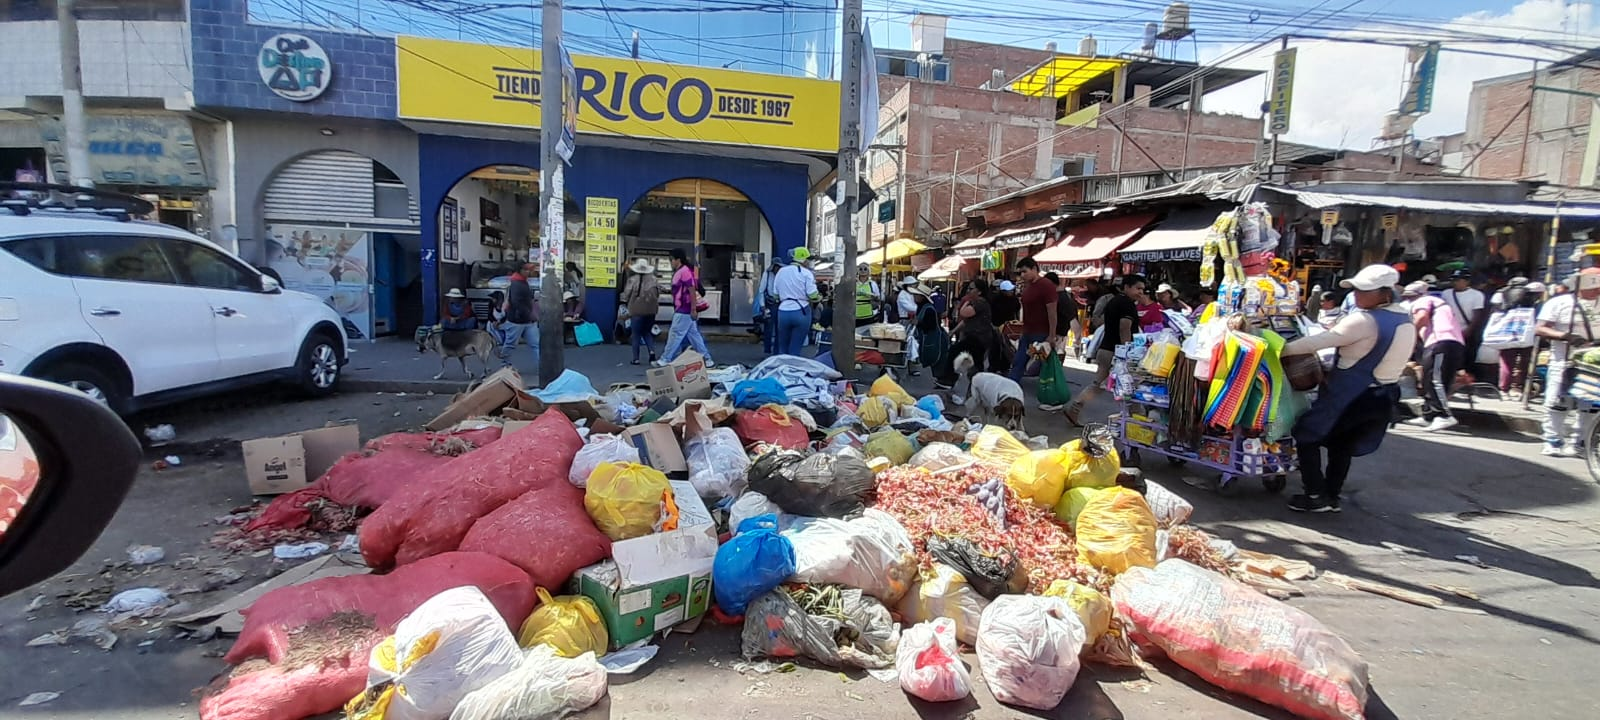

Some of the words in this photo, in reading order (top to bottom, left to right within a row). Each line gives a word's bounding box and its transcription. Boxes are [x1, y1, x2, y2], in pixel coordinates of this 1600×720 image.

[495, 74, 541, 95] TIEND
[576, 67, 713, 124] RICO
[718, 95, 757, 115] DESDE
[761, 100, 791, 118] 1967
[594, 217, 616, 229] 14.50
[1170, 249, 1201, 260] LLAVES
